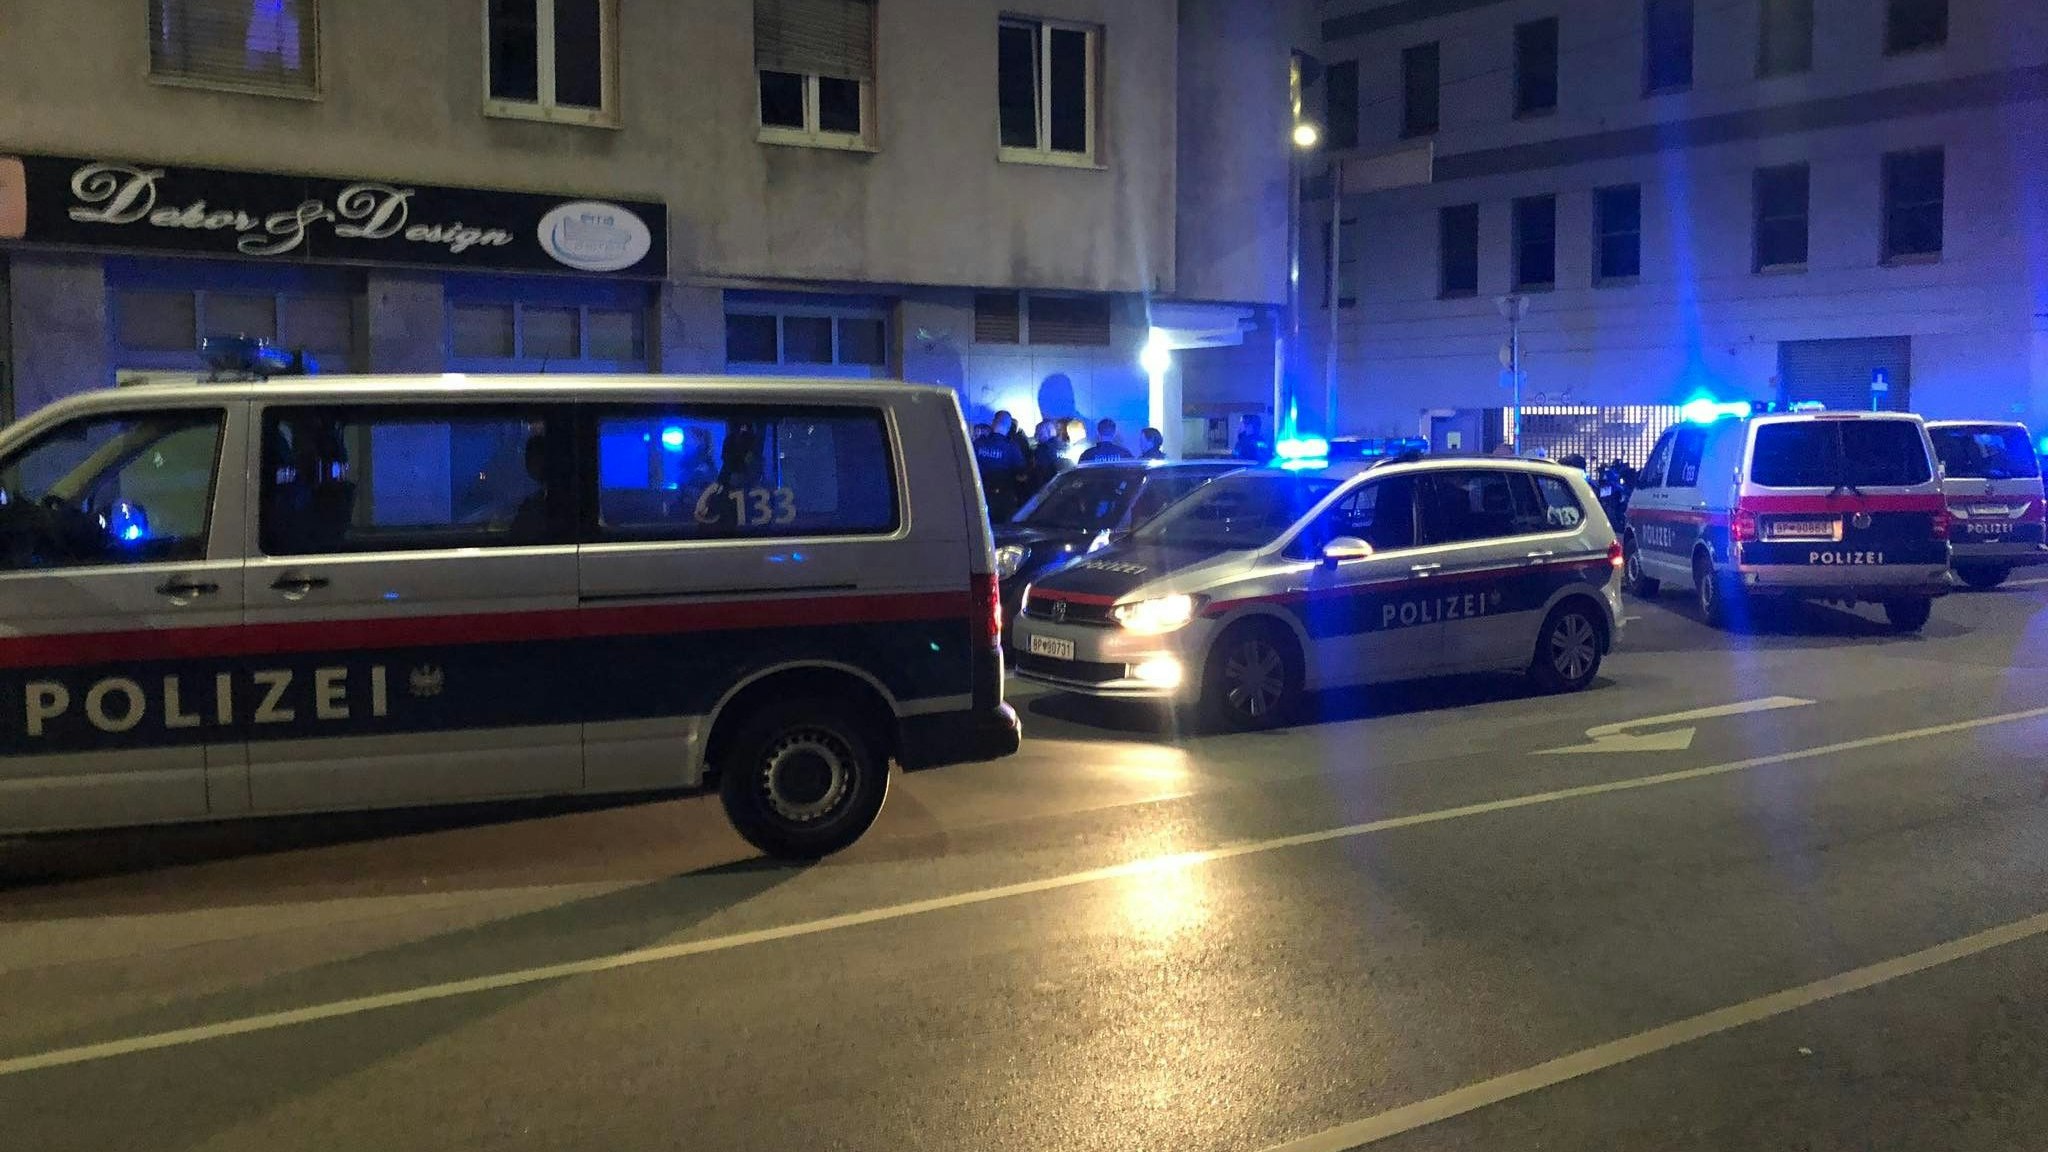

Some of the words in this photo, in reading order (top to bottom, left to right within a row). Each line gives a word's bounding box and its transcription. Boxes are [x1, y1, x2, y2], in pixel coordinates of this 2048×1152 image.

[68, 162, 259, 231] Dekor
[237, 199, 335, 256] &
[335, 182, 514, 254] Design
[728, 486, 797, 526] 133
[1967, 522, 2013, 534] POLIZEI
[1809, 551, 1883, 564] POLIZEI
[1382, 592, 1486, 627] POLIZEI
[24, 663, 388, 737] POLIZEI
